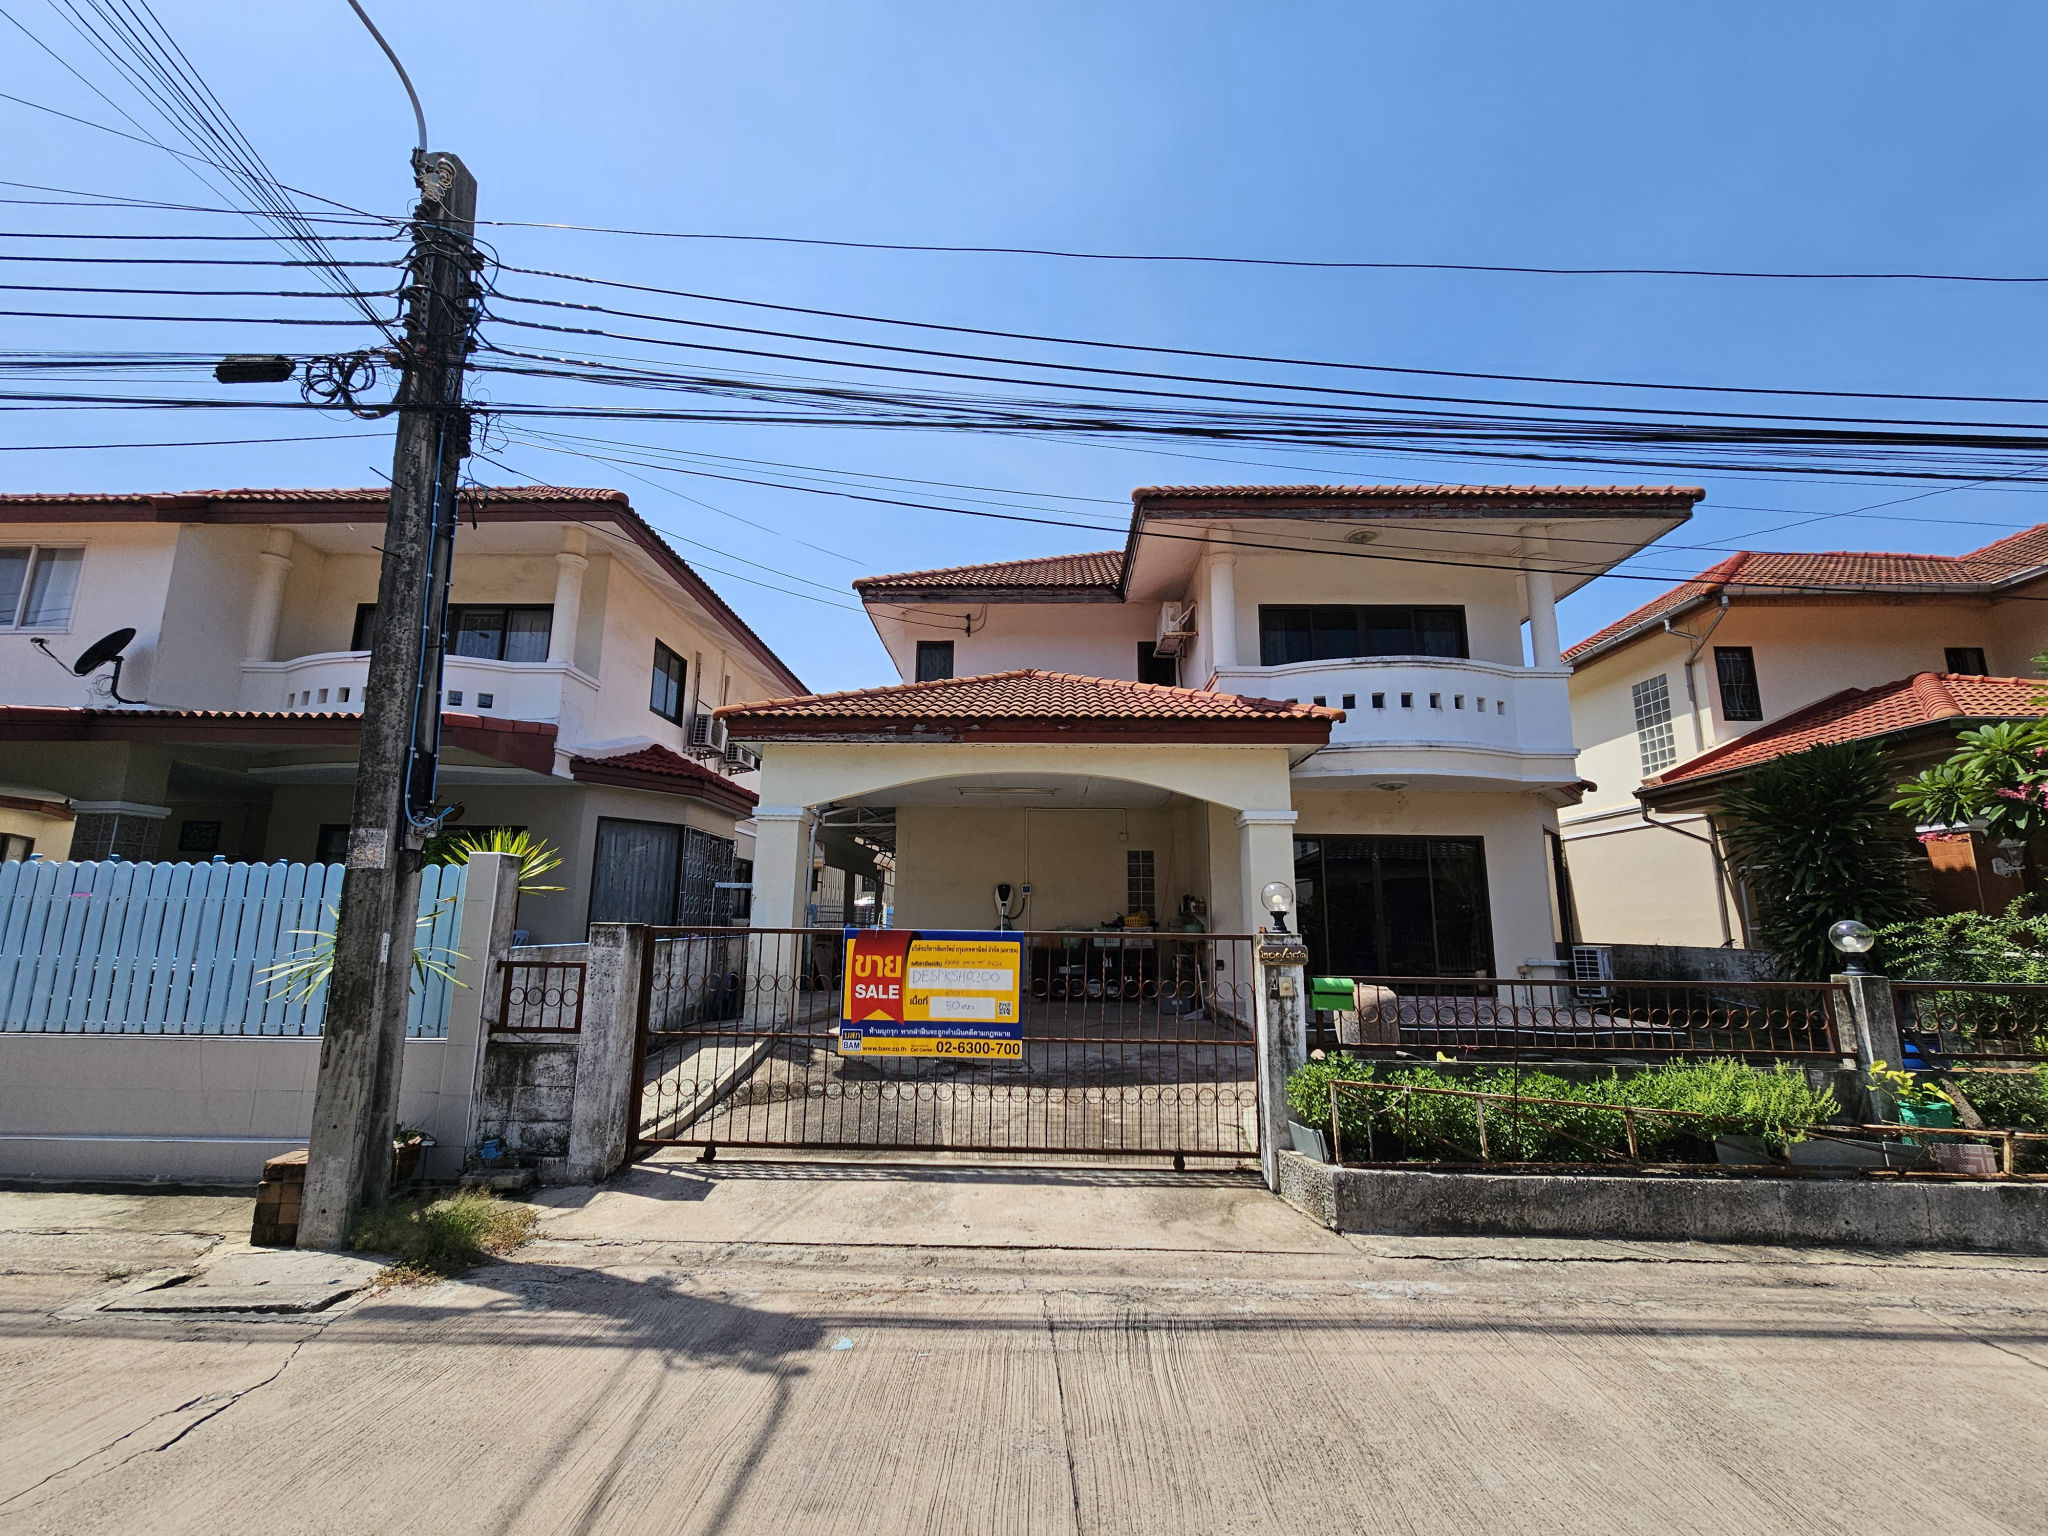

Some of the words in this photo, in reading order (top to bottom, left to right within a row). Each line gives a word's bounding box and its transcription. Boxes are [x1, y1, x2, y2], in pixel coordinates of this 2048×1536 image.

[855, 955, 902, 978] ขาย
[855, 984, 900, 999] SALE
[844, 1041, 860, 1049] BAM
[936, 1041, 1020, 1055] 02-6300-700
